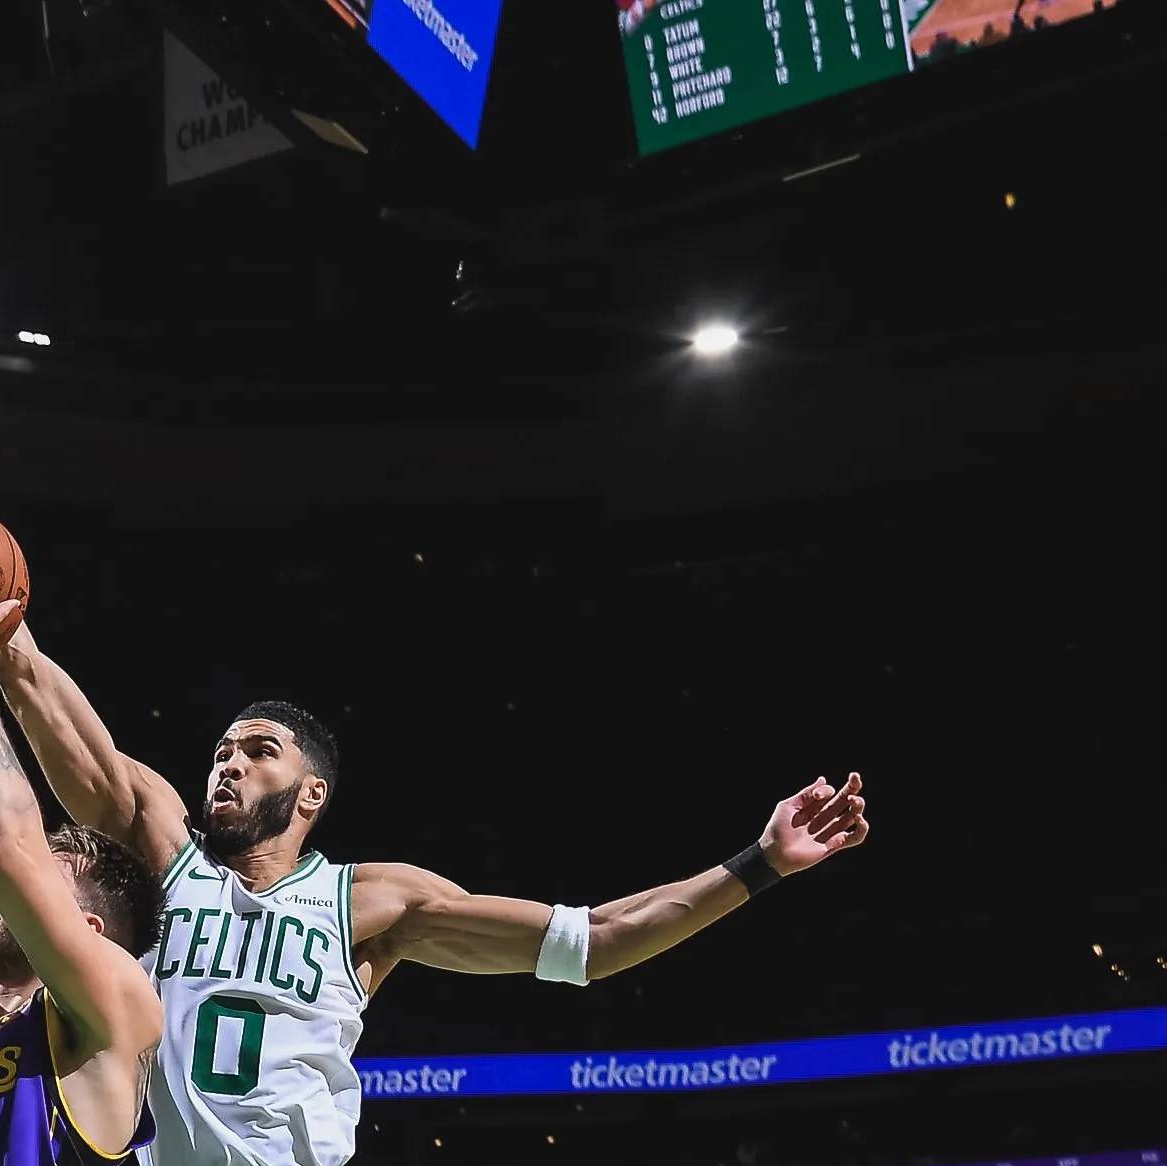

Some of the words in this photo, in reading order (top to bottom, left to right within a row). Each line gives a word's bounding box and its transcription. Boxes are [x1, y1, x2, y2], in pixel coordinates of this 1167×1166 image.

[663, 18, 700, 45] TATUM
[668, 55, 702, 81] WHITE
[672, 66, 732, 100] PRITCHARD
[675, 88, 725, 119] HORFORD
[284, 893, 334, 909] Amica
[154, 907, 331, 1005] CELTICS
[190, 993, 267, 1097] 0
[887, 1023, 1112, 1069] ticketmaster
[569, 1054, 778, 1090] ticketmaster
